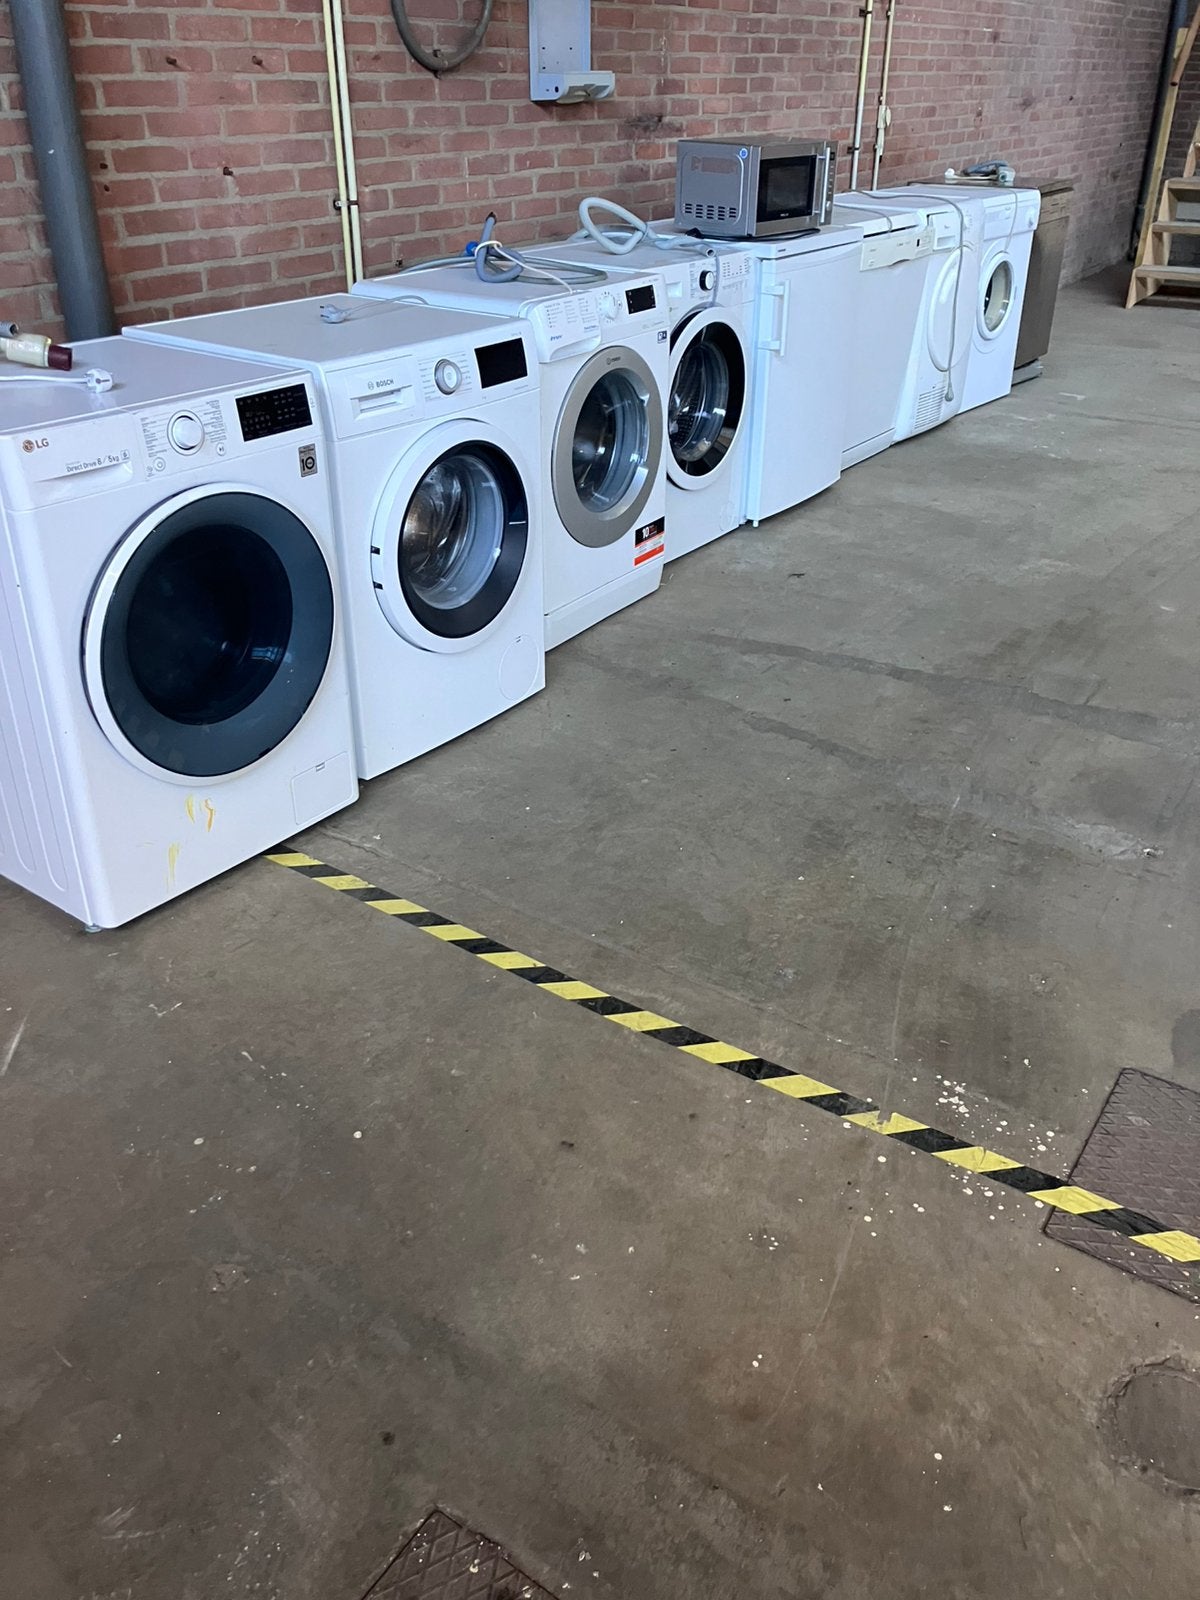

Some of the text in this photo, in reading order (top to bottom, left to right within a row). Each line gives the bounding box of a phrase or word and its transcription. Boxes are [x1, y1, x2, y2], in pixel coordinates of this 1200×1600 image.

[375, 379, 394, 388] BOSCH
[35, 438, 49, 449] LG
[66, 464, 83, 473] Direct
[83, 461, 97, 469] Drive
